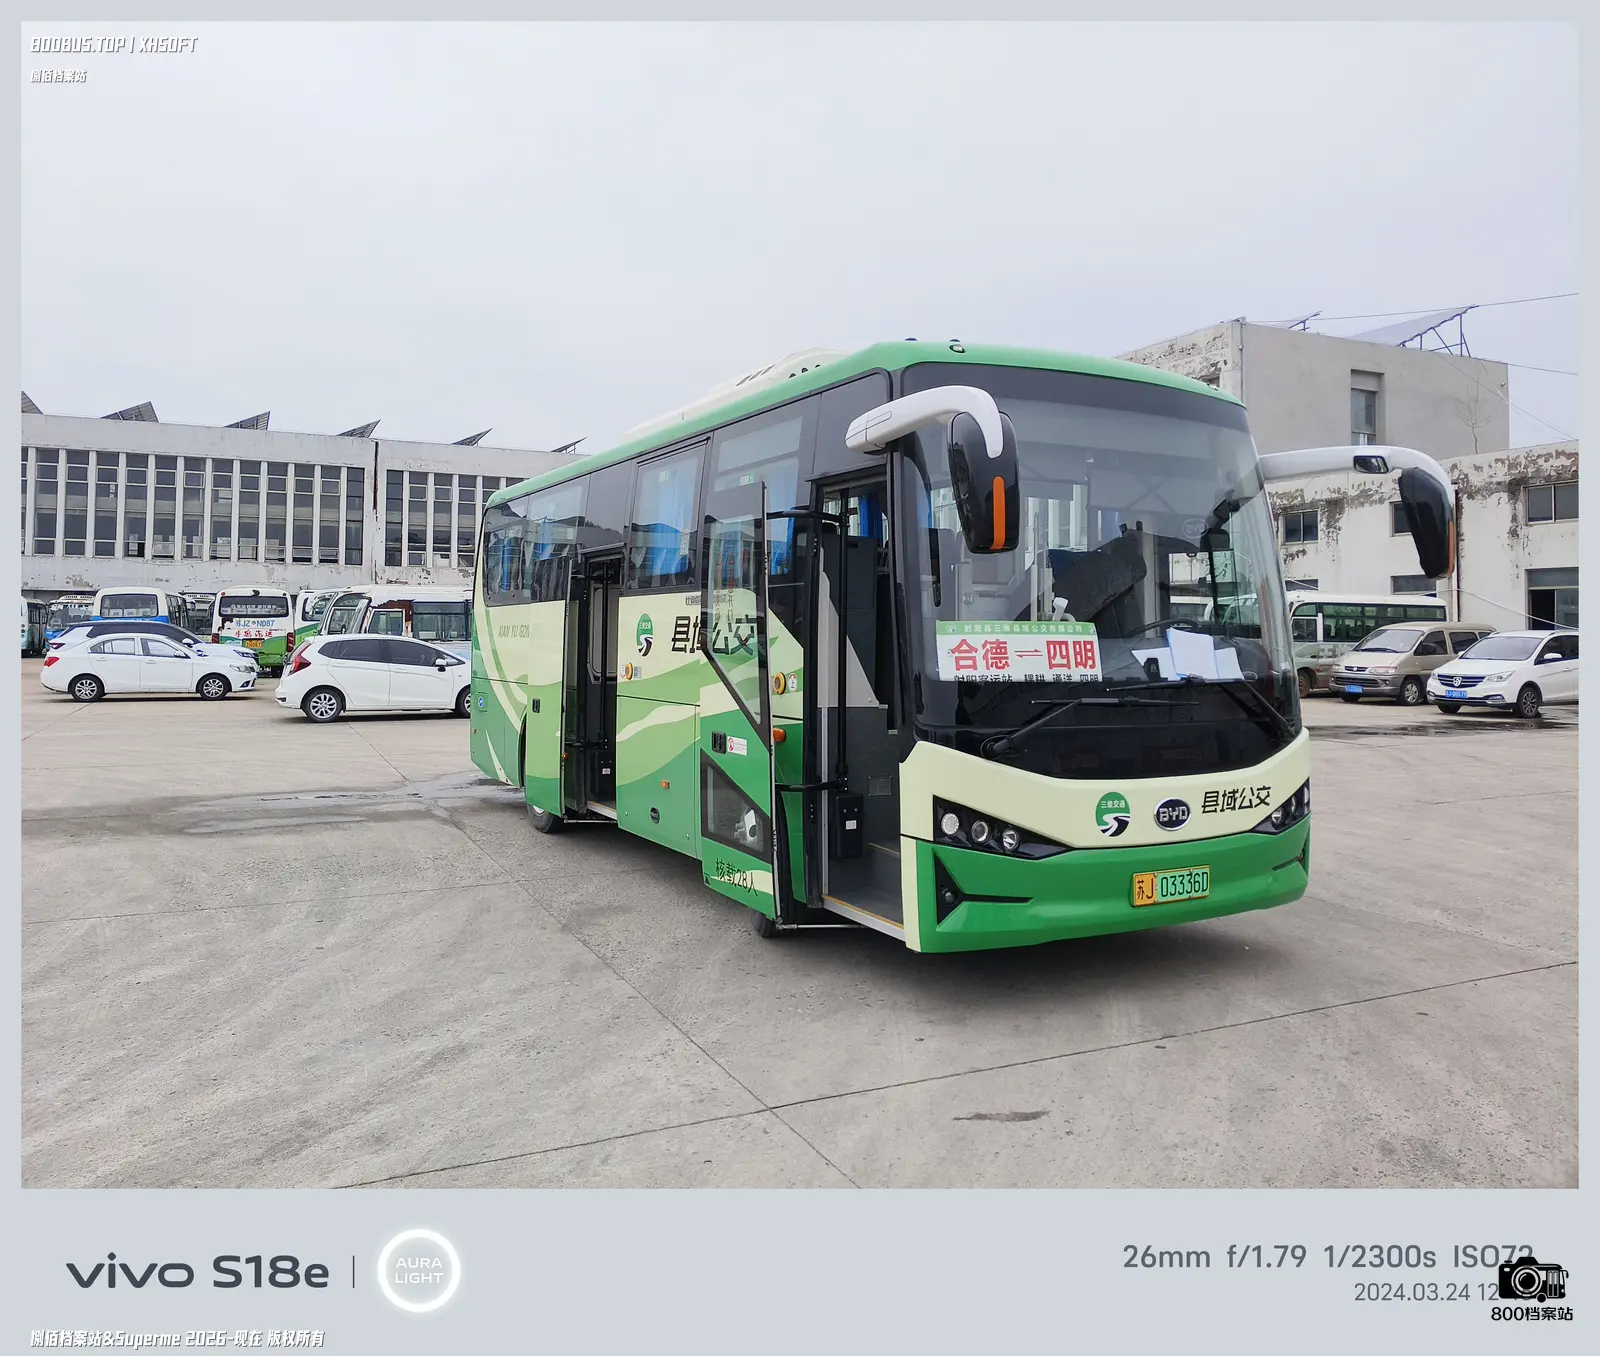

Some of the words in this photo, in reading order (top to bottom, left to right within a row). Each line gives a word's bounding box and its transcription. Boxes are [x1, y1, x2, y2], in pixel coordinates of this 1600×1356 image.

[951, 638, 1010, 671] 合德
[1046, 640, 1097, 670] 四明
[1159, 806, 1188, 822] BYD
[1201, 785, 1272, 814] 县域公交
[716, 857, 758, 897] 核载28人
